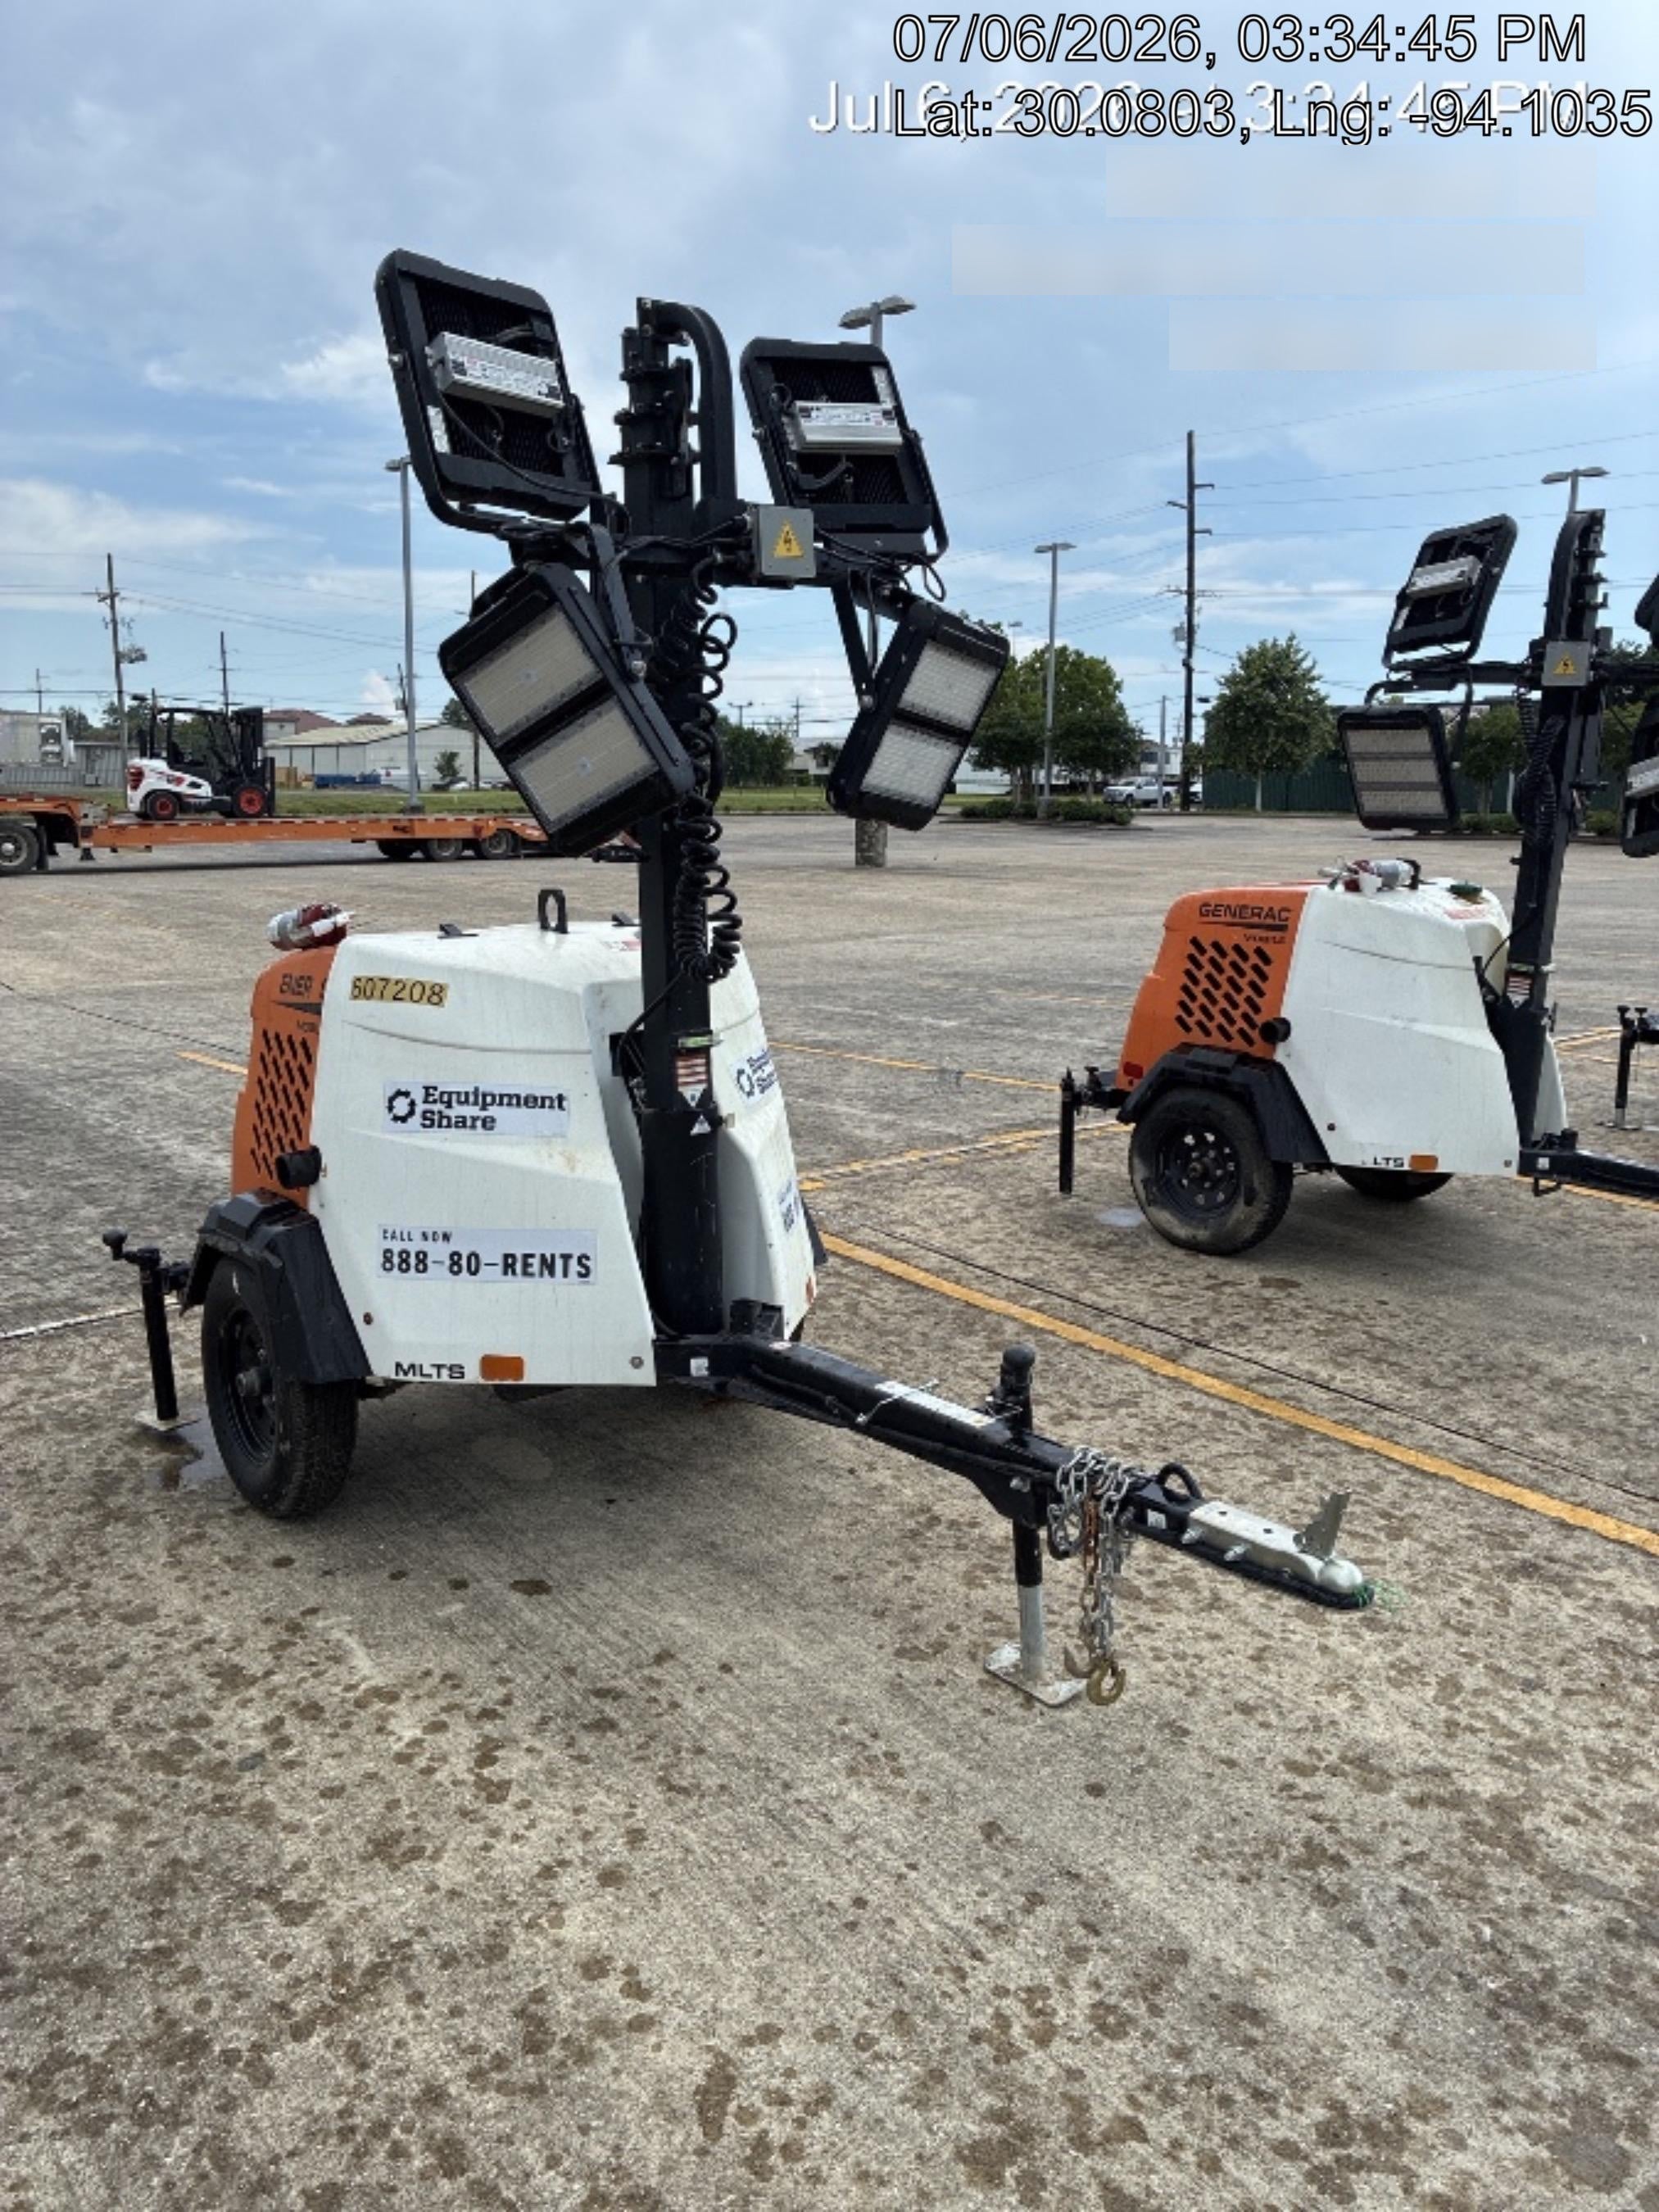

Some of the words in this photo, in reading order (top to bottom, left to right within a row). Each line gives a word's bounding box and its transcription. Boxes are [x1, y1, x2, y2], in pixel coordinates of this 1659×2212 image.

[1199, 903, 1291, 922] GENERAC
[350, 977, 445, 1006] 607208
[422, 1086, 567, 1111] Equipment
[420, 1109, 497, 1131] Share
[383, 1229, 414, 1242] CALL
[421, 1231, 452, 1244] NOW
[381, 1248, 592, 1279] 888-80-RENTS
[394, 1362, 466, 1380] MLTS
